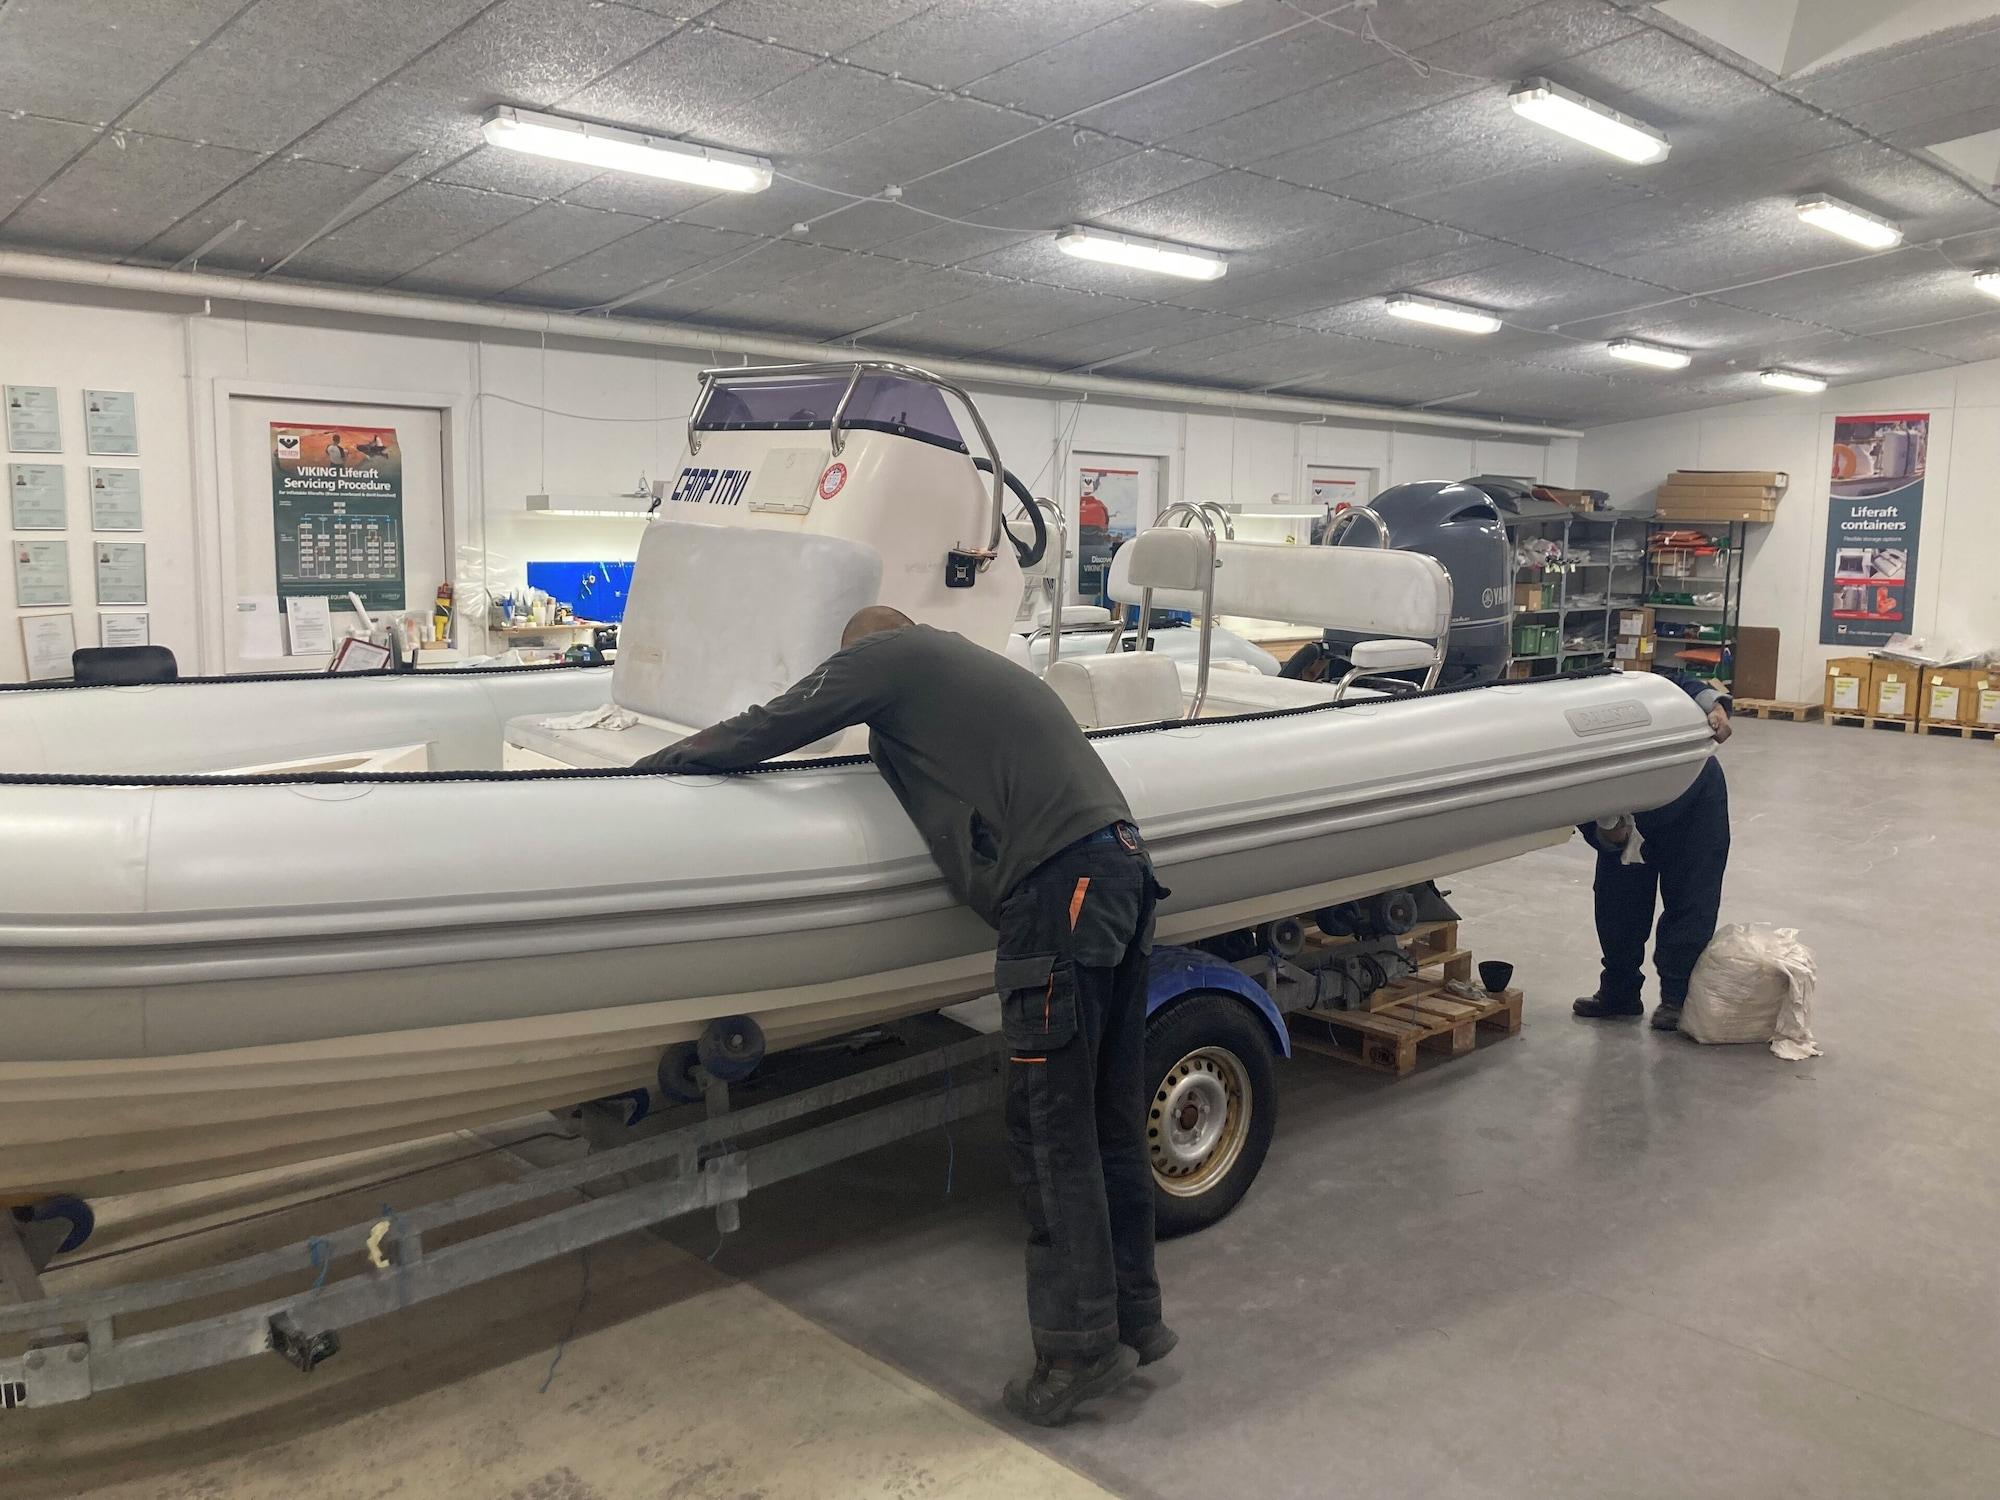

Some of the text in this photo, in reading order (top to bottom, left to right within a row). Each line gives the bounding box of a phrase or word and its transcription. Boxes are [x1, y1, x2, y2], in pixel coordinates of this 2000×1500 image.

[297, 466, 379, 479] VIKING Liferaft
[284, 478, 391, 491] Servicing Procedure
[1851, 506, 1898, 517] Liferaft
[1841, 519, 1907, 530] containers
